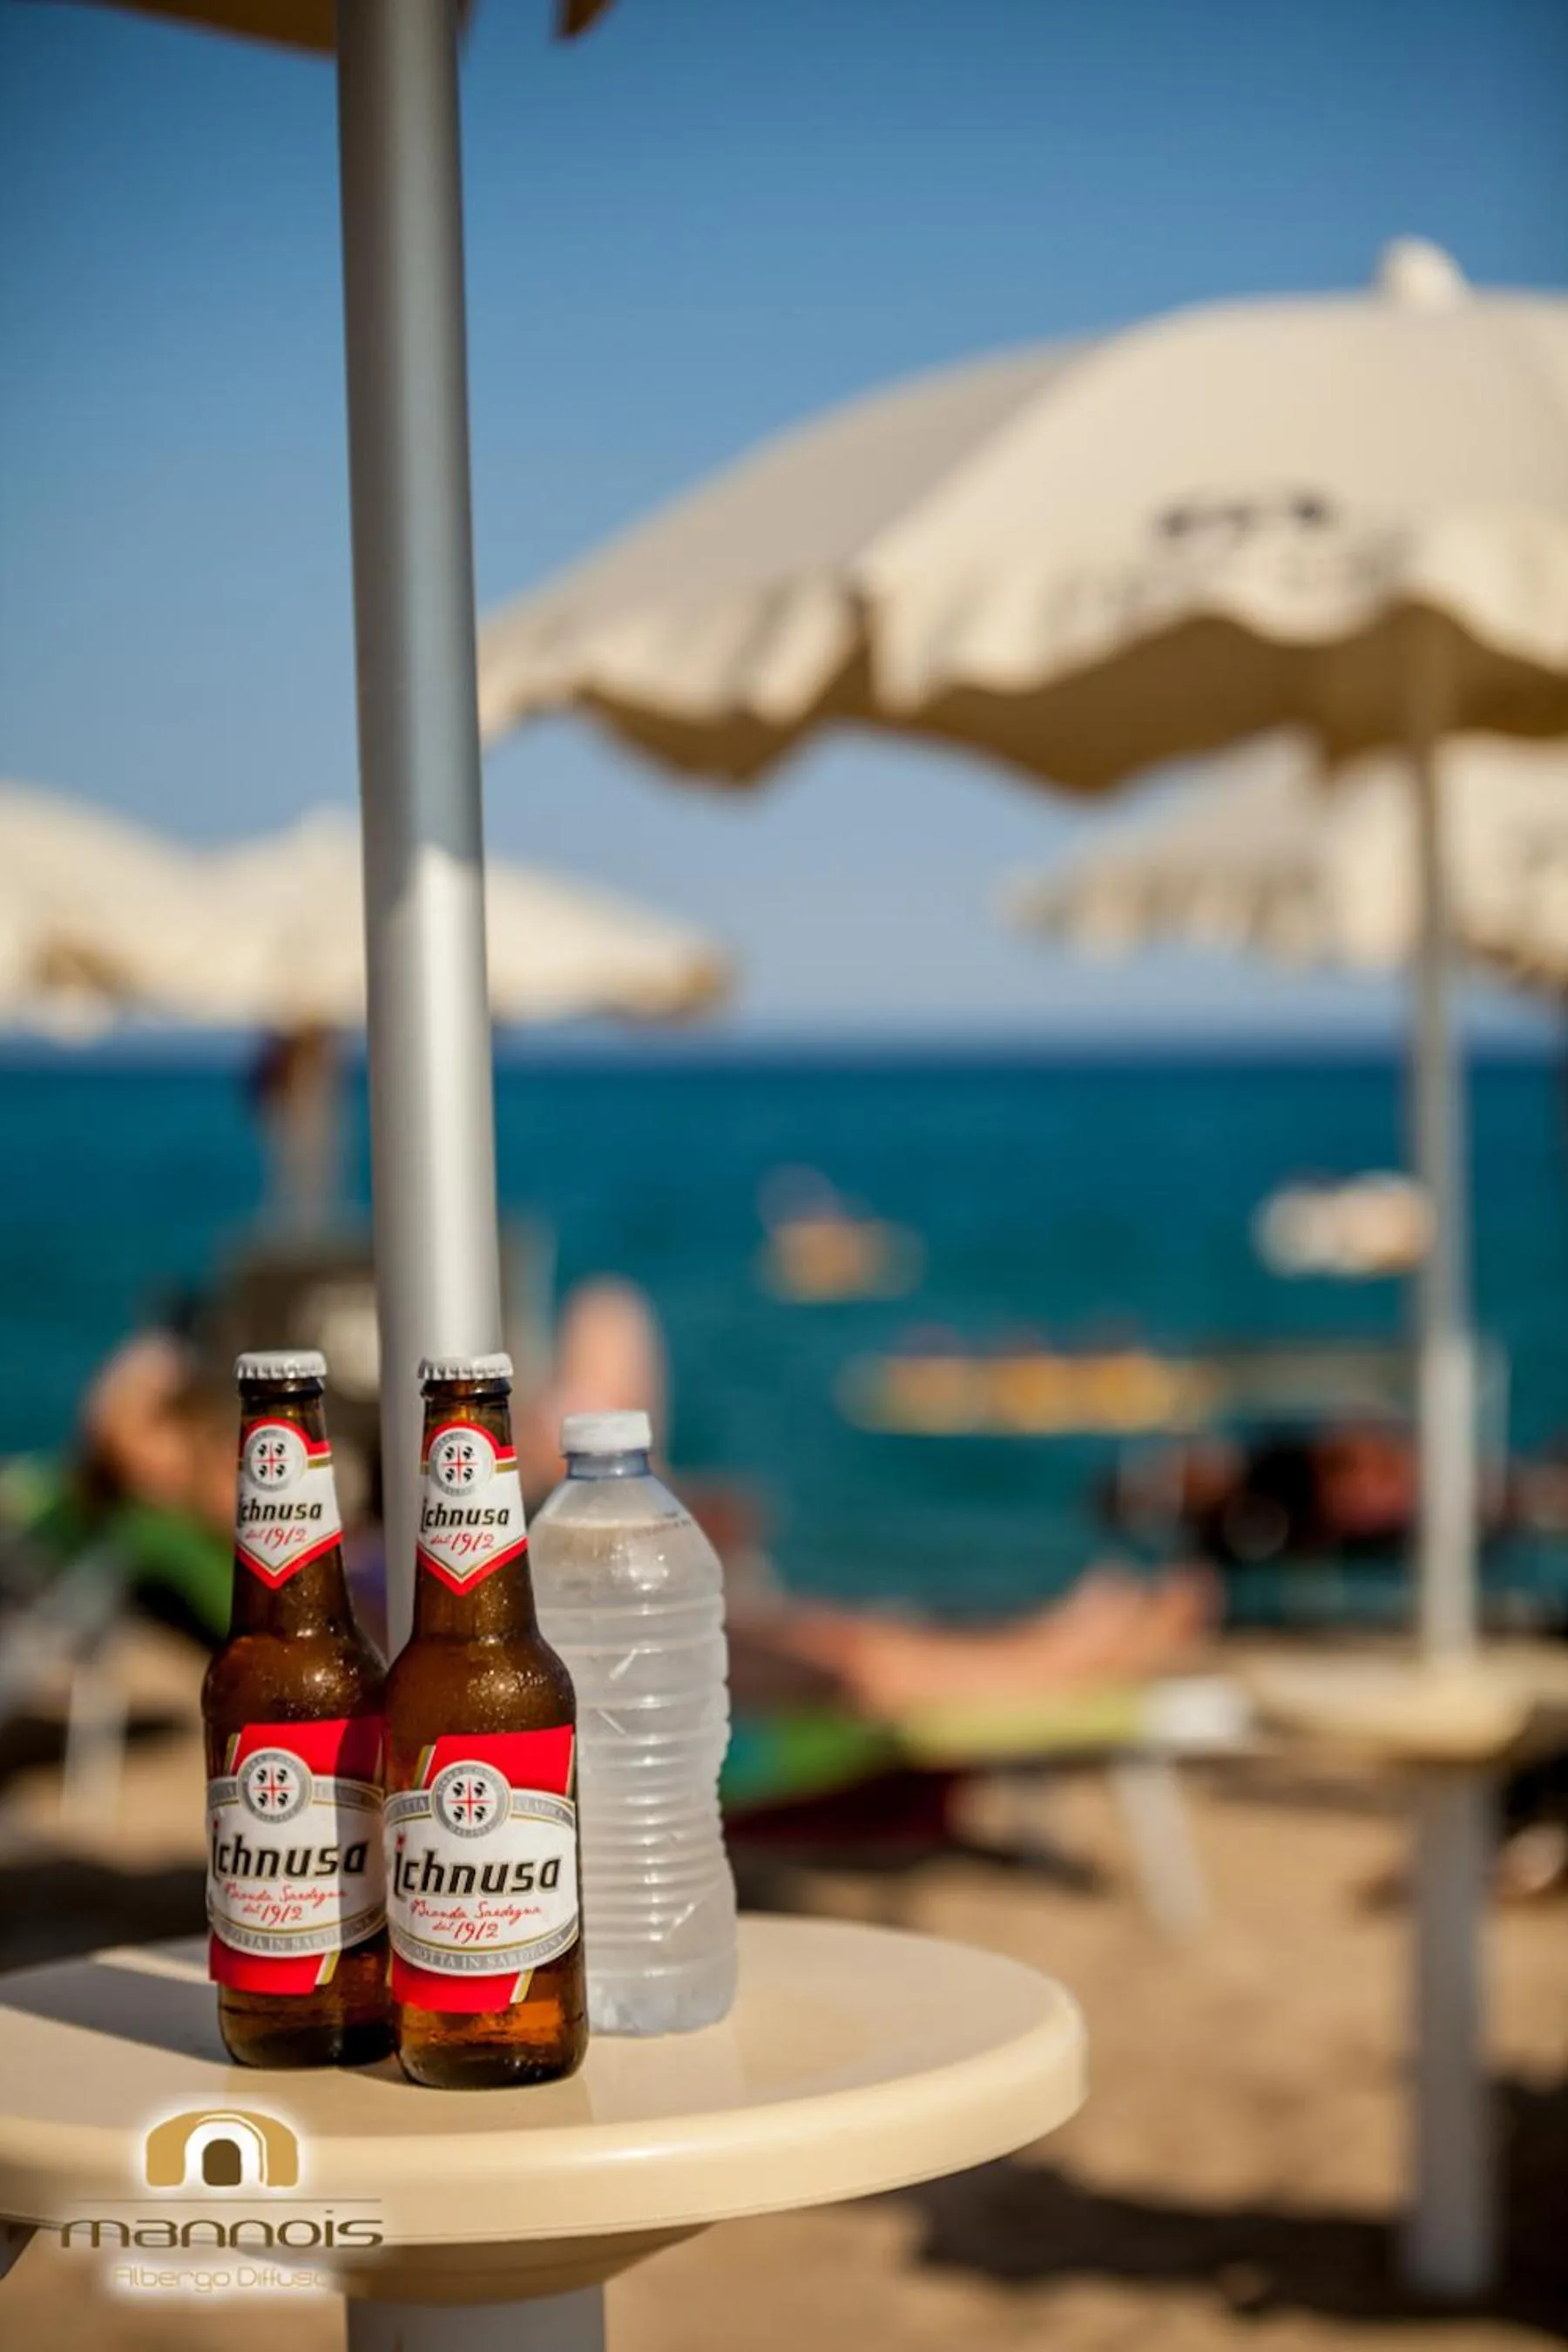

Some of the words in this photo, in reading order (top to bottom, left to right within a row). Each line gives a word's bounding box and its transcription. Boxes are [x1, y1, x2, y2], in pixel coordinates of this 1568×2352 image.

[264, 1525, 307, 1551] 1912
[450, 1531, 494, 1557] 1912
[260, 1904, 304, 1928] 1912
[453, 1919, 500, 1945] 1912
